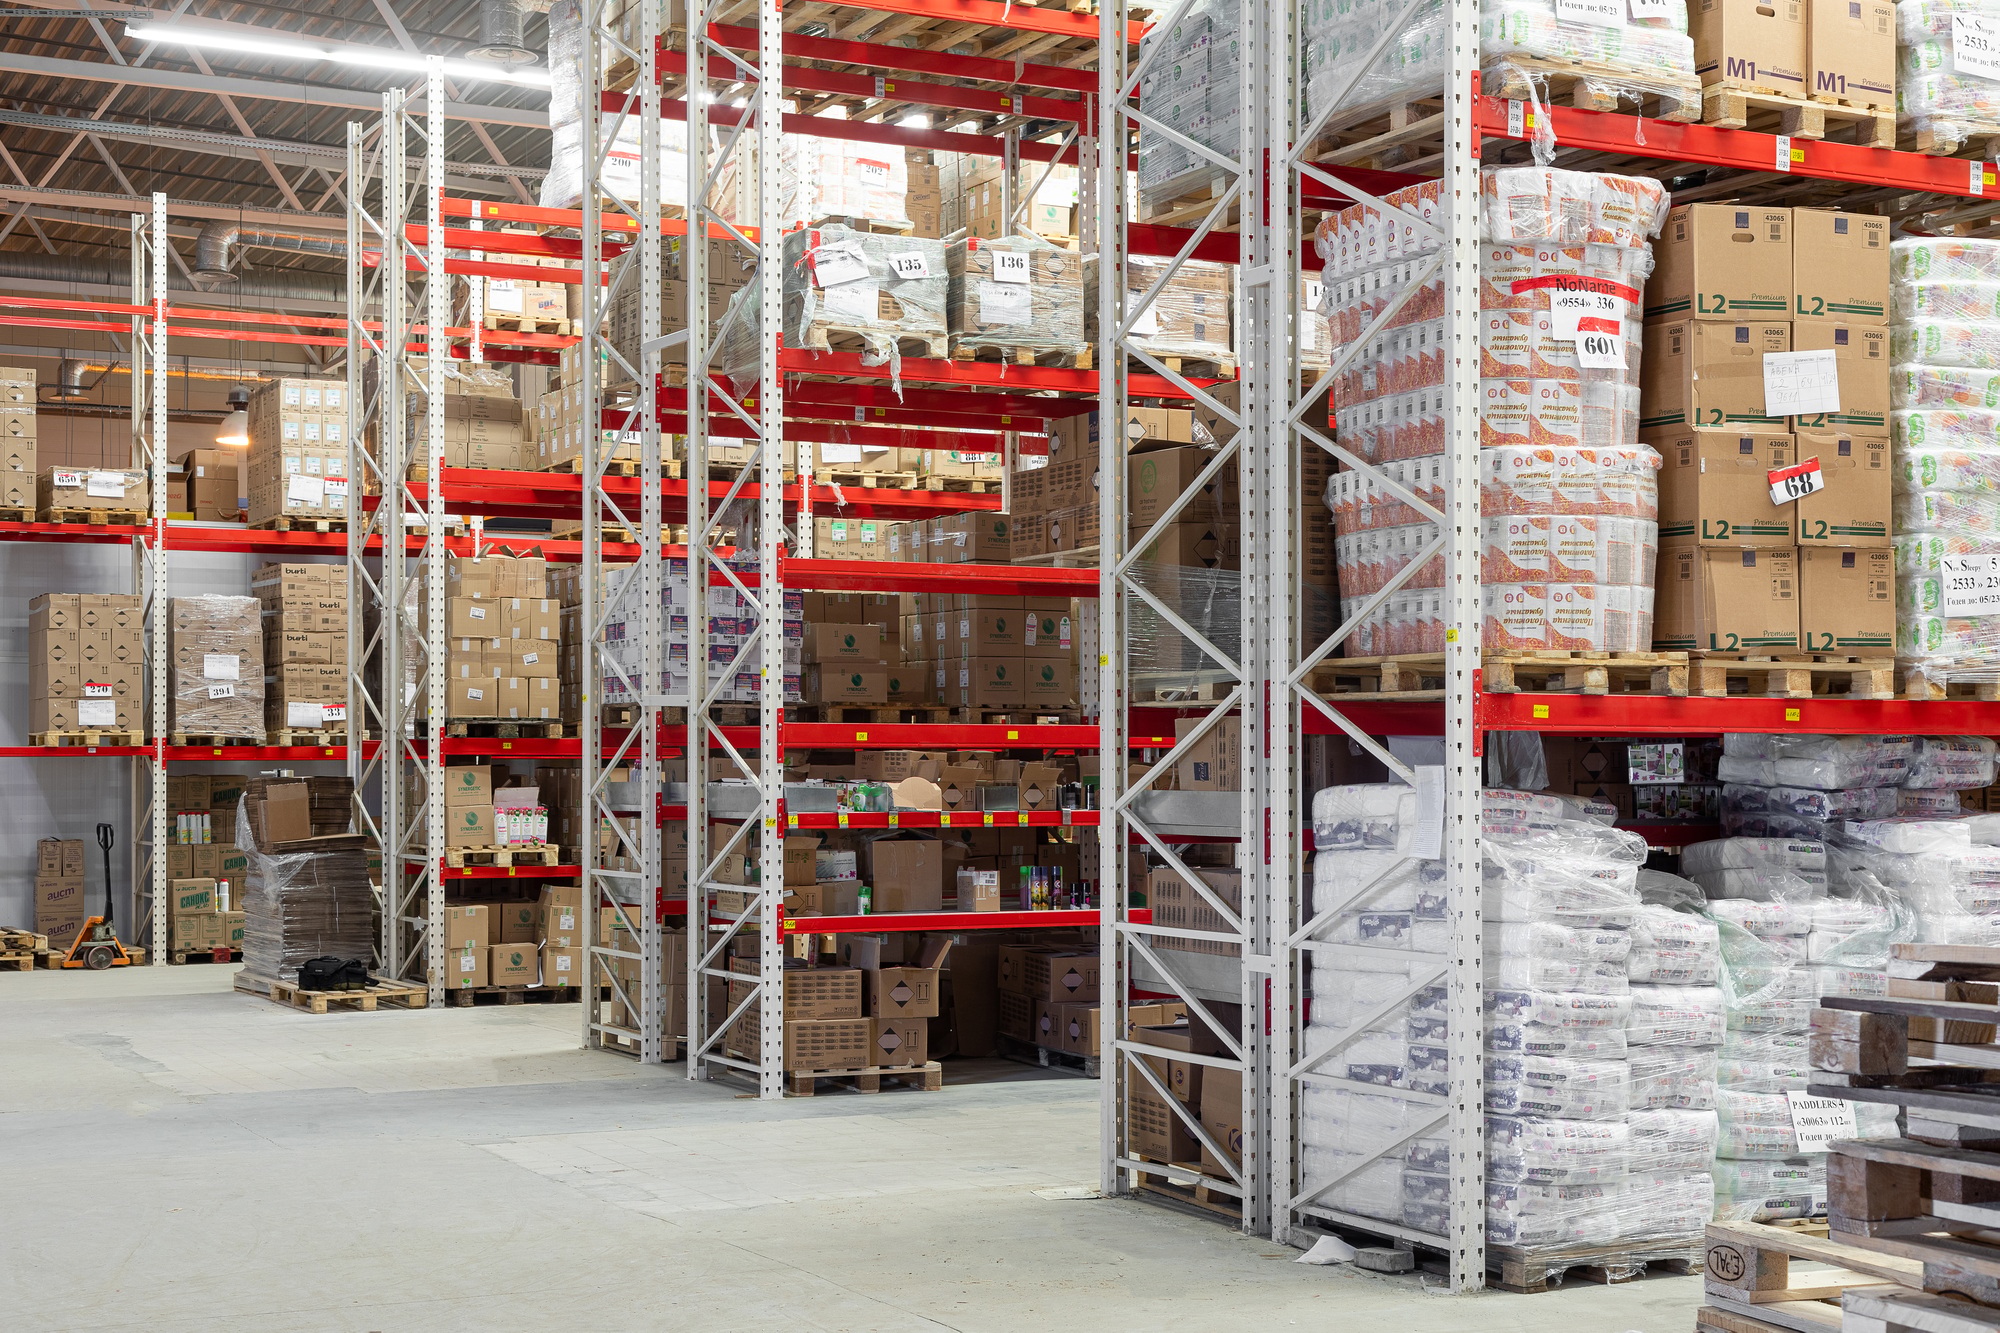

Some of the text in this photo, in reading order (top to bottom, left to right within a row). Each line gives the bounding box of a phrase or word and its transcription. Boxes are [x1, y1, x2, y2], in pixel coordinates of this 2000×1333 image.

[1599, 5, 1618, 15] 05/23
[1964, 35, 1988, 51] 2533
[1726, 56, 1803, 80] M1 Premium
[1817, 71, 1892, 94] M1 Premium
[612, 158, 631, 168] 200
[866, 164, 883, 175] 202
[1672, 213, 1687, 222] 43065
[1765, 214, 1785, 222] 43065
[1864, 221, 1883, 230] 43065
[898, 258, 921, 272] 135
[1000, 257, 1024, 269] 136
[1597, 296, 1614, 310] 336
[1698, 293, 1787, 314] L2 Premium
[1797, 294, 1884, 316] L2 Premium
[1669, 327, 1683, 335] 43065
[1864, 332, 1883, 340] 43065
[1696, 408, 1724, 427] L2
[1676, 439, 1692, 448] 43065
[1784, 471, 1814, 497] 68
[1702, 519, 1729, 540] L2
[1802, 519, 1828, 540] L2
[1678, 553, 1693, 561] 43065
[1961, 559, 1981, 572] Sleepy
[1991, 558, 1997, 570] 5
[1953, 577, 1975, 590] 2533
[1710, 632, 1739, 652] L2
[1807, 632, 1834, 651] L2
[328, 708, 341, 716] 33
[180, 891, 210, 909] САНОКС
[1793, 1099, 1845, 1109] PADDLERS 4
[1796, 1118, 1828, 1127] «30063»
[1800, 1133, 1822, 1142] Годен
